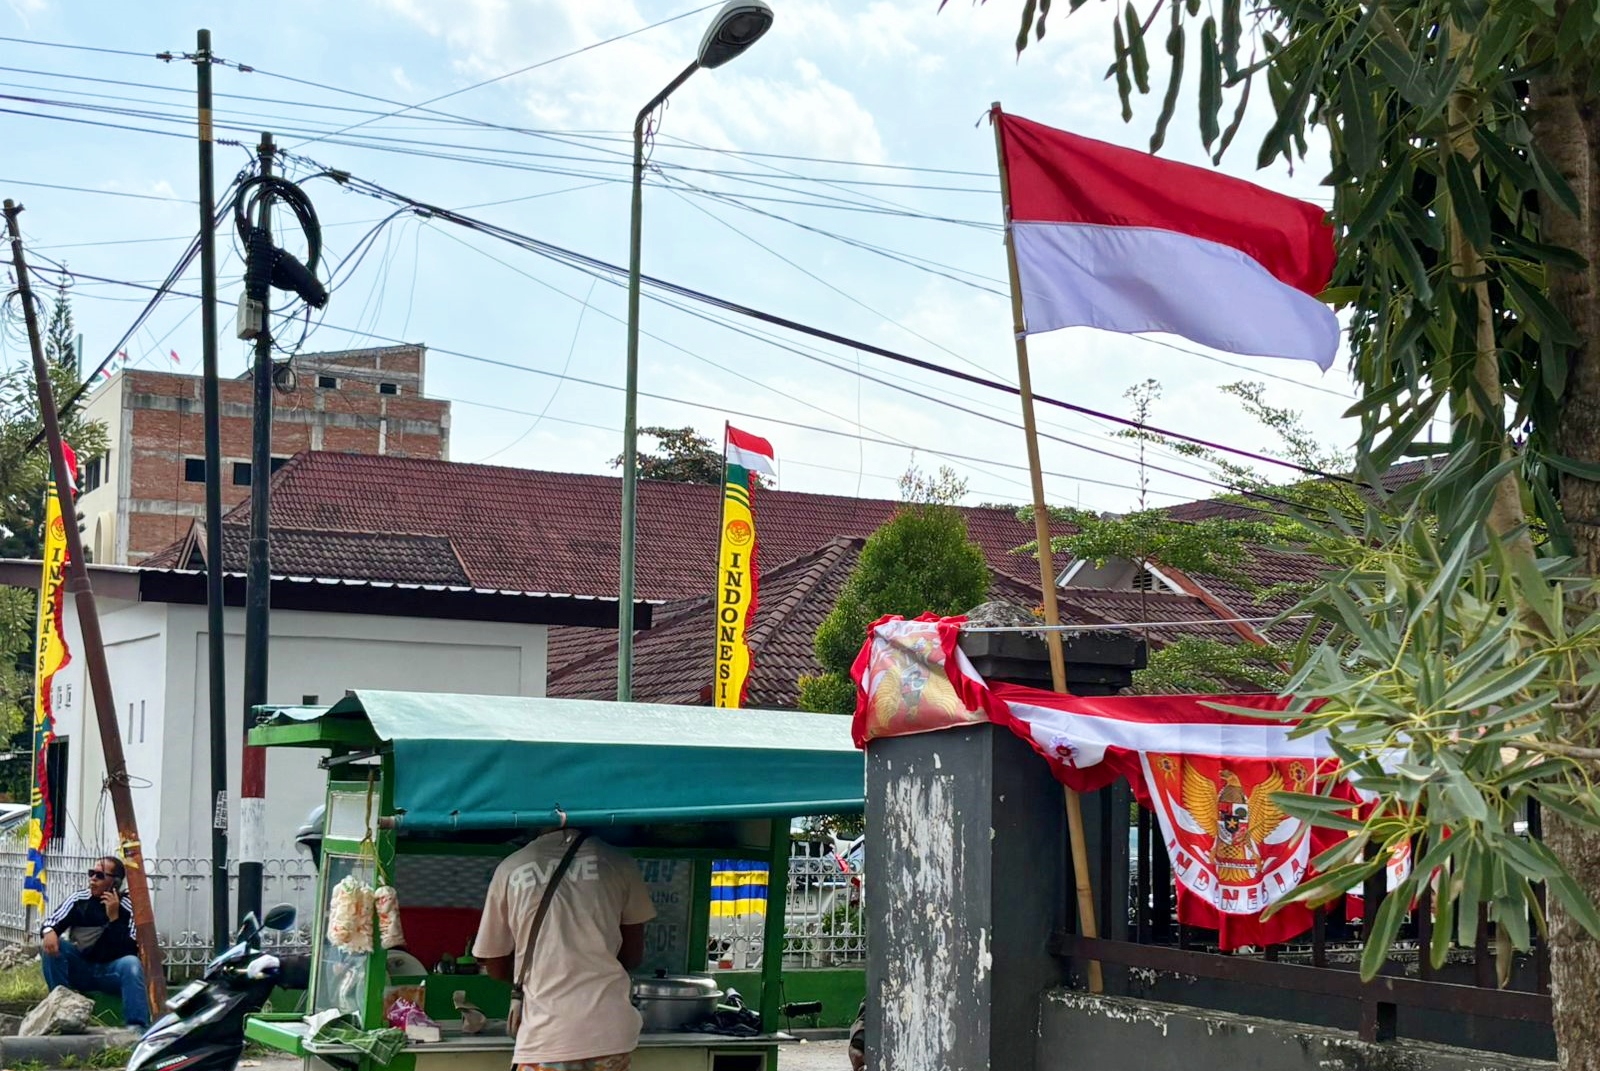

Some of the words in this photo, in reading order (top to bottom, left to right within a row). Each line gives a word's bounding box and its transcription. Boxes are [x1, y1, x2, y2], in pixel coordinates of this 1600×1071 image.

[39, 547, 61, 708] INDONESI
[508, 855, 599, 889] REVVE
[1166, 839, 1305, 911] INDNESIA
[156, 1055, 189, 1069] HONDA
